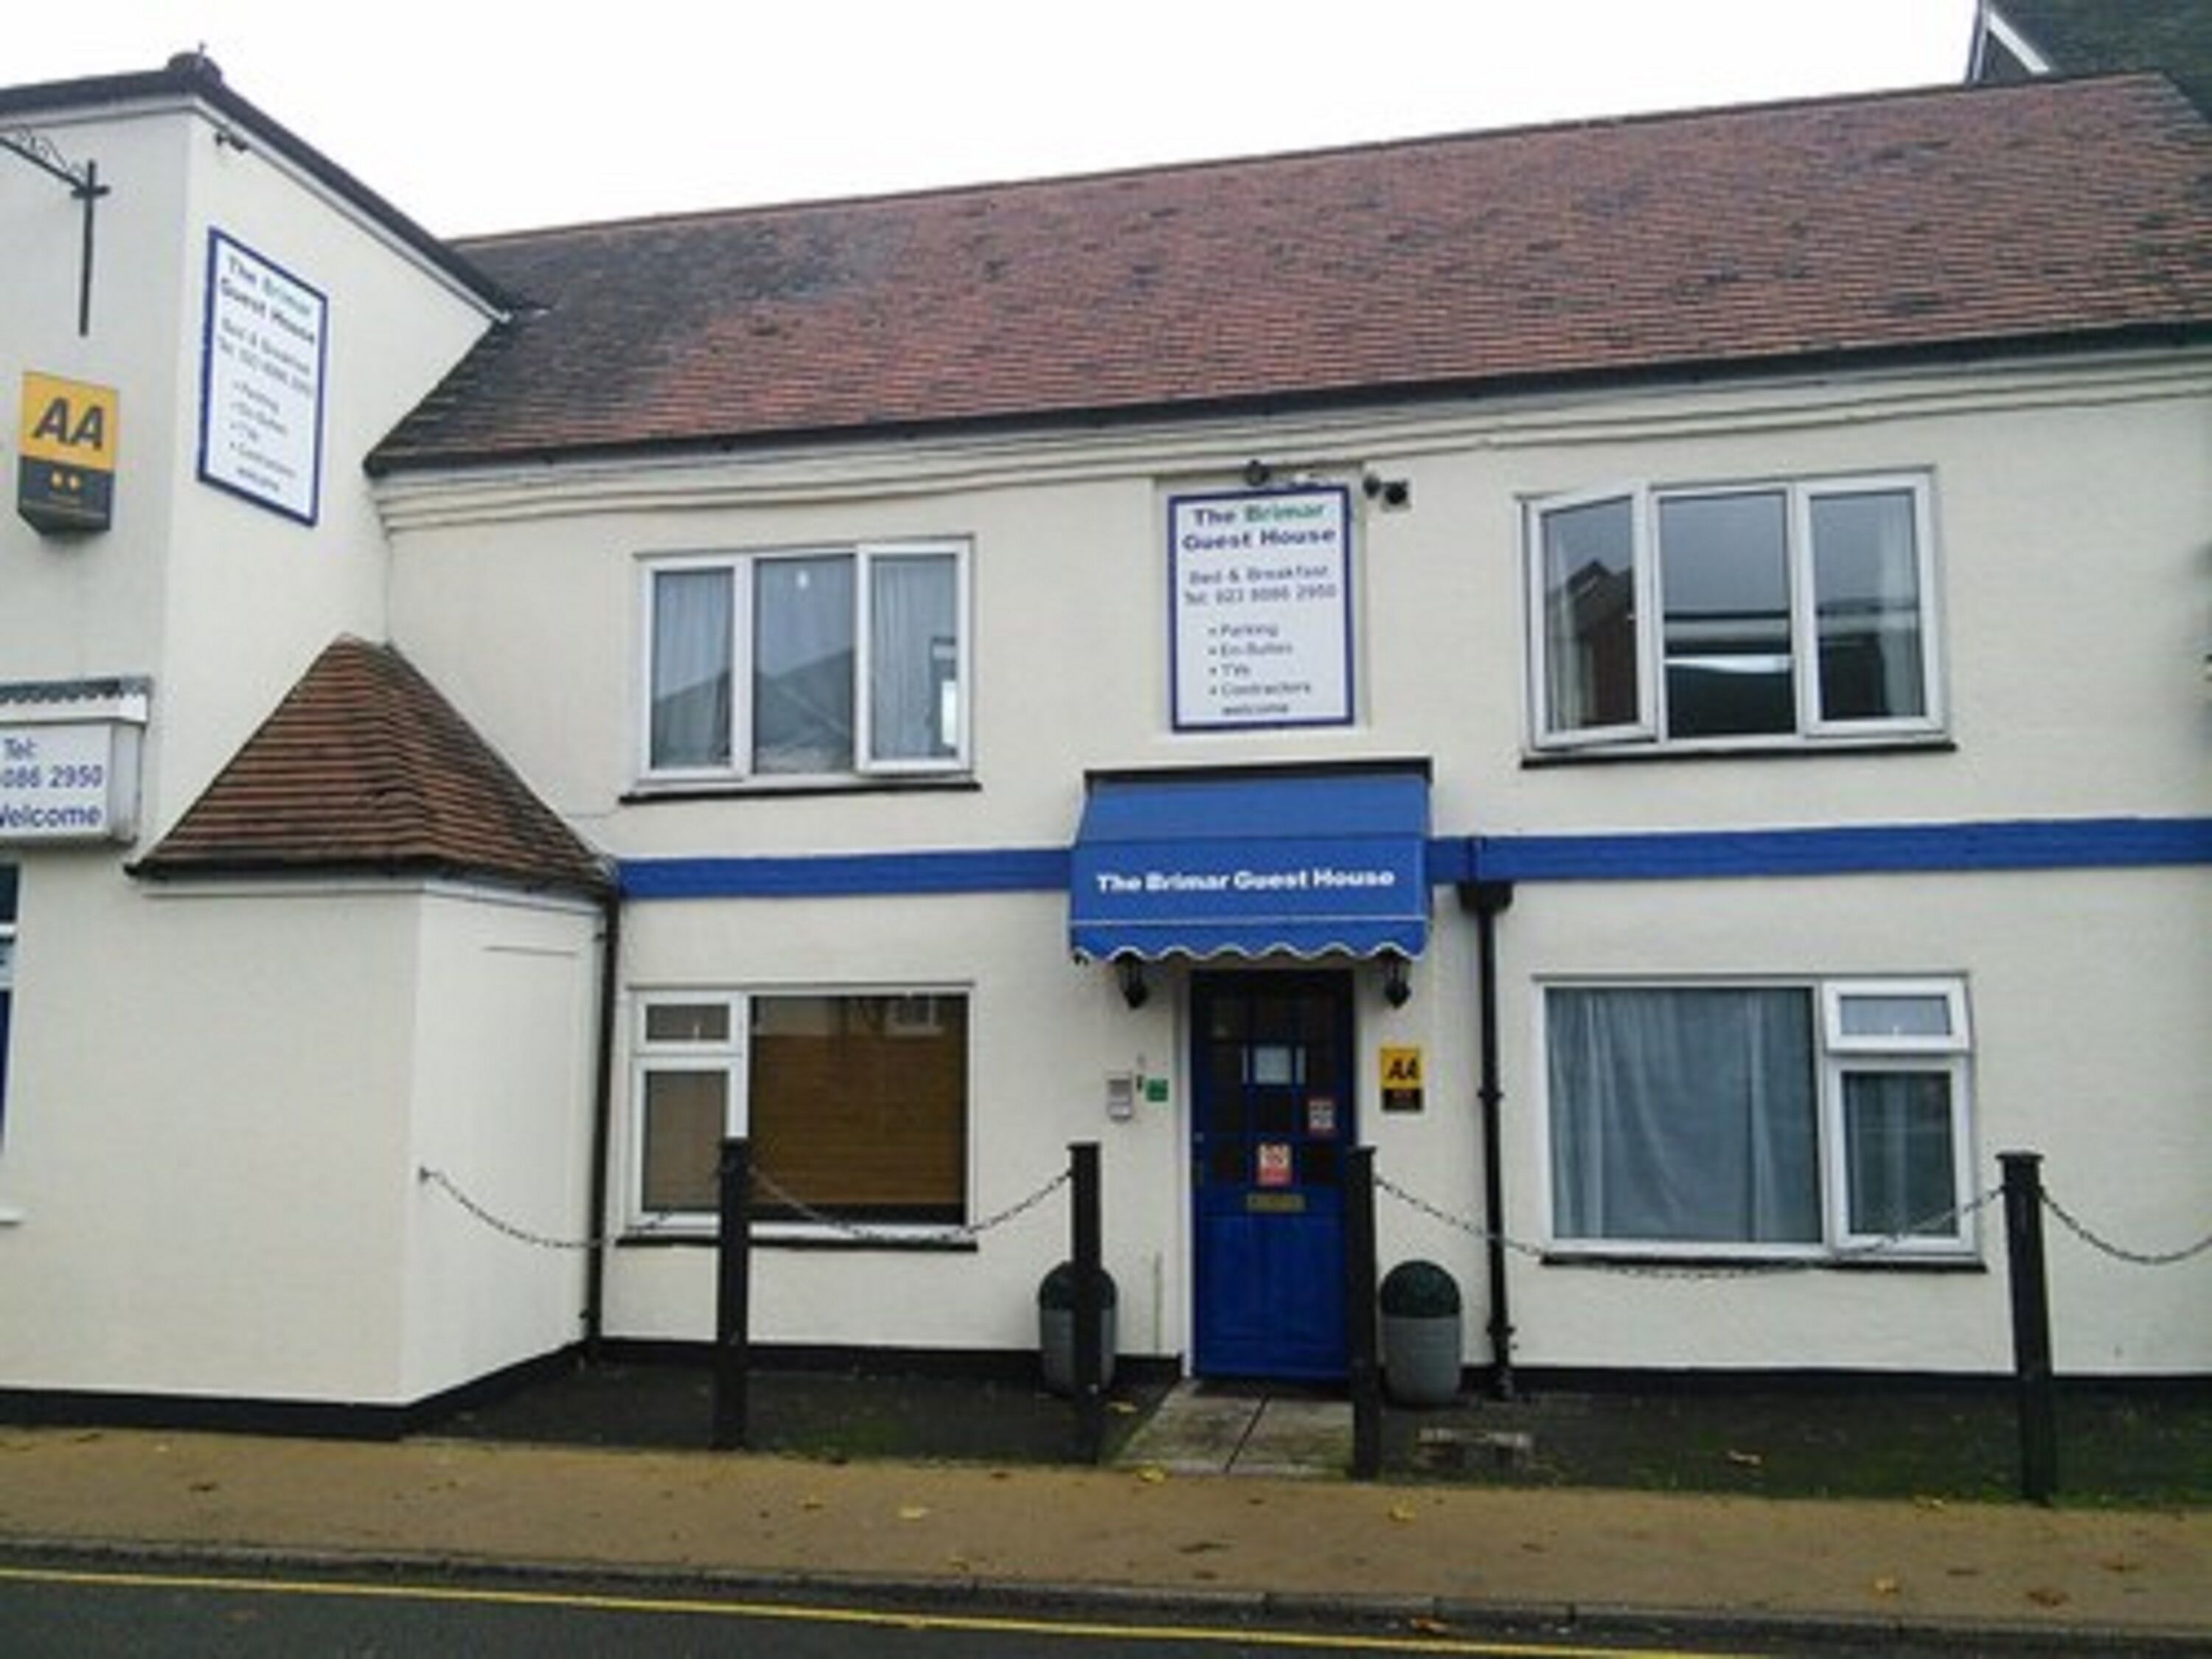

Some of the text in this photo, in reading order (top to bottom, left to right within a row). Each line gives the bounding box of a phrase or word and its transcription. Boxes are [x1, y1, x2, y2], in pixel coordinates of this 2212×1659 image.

[32, 396, 104, 451] AA
[1193, 504, 1325, 526] The Brimar
[1182, 528, 1336, 551] Guest House
[1189, 566, 1328, 584] Bed & Breakfast
[1220, 625, 1279, 638] Parking
[1220, 683, 1311, 697] Contractors
[0, 765, 102, 788] 086 2950
[1096, 867, 1395, 892] The Brimar Guest House
[1388, 1057, 1420, 1080] AA
